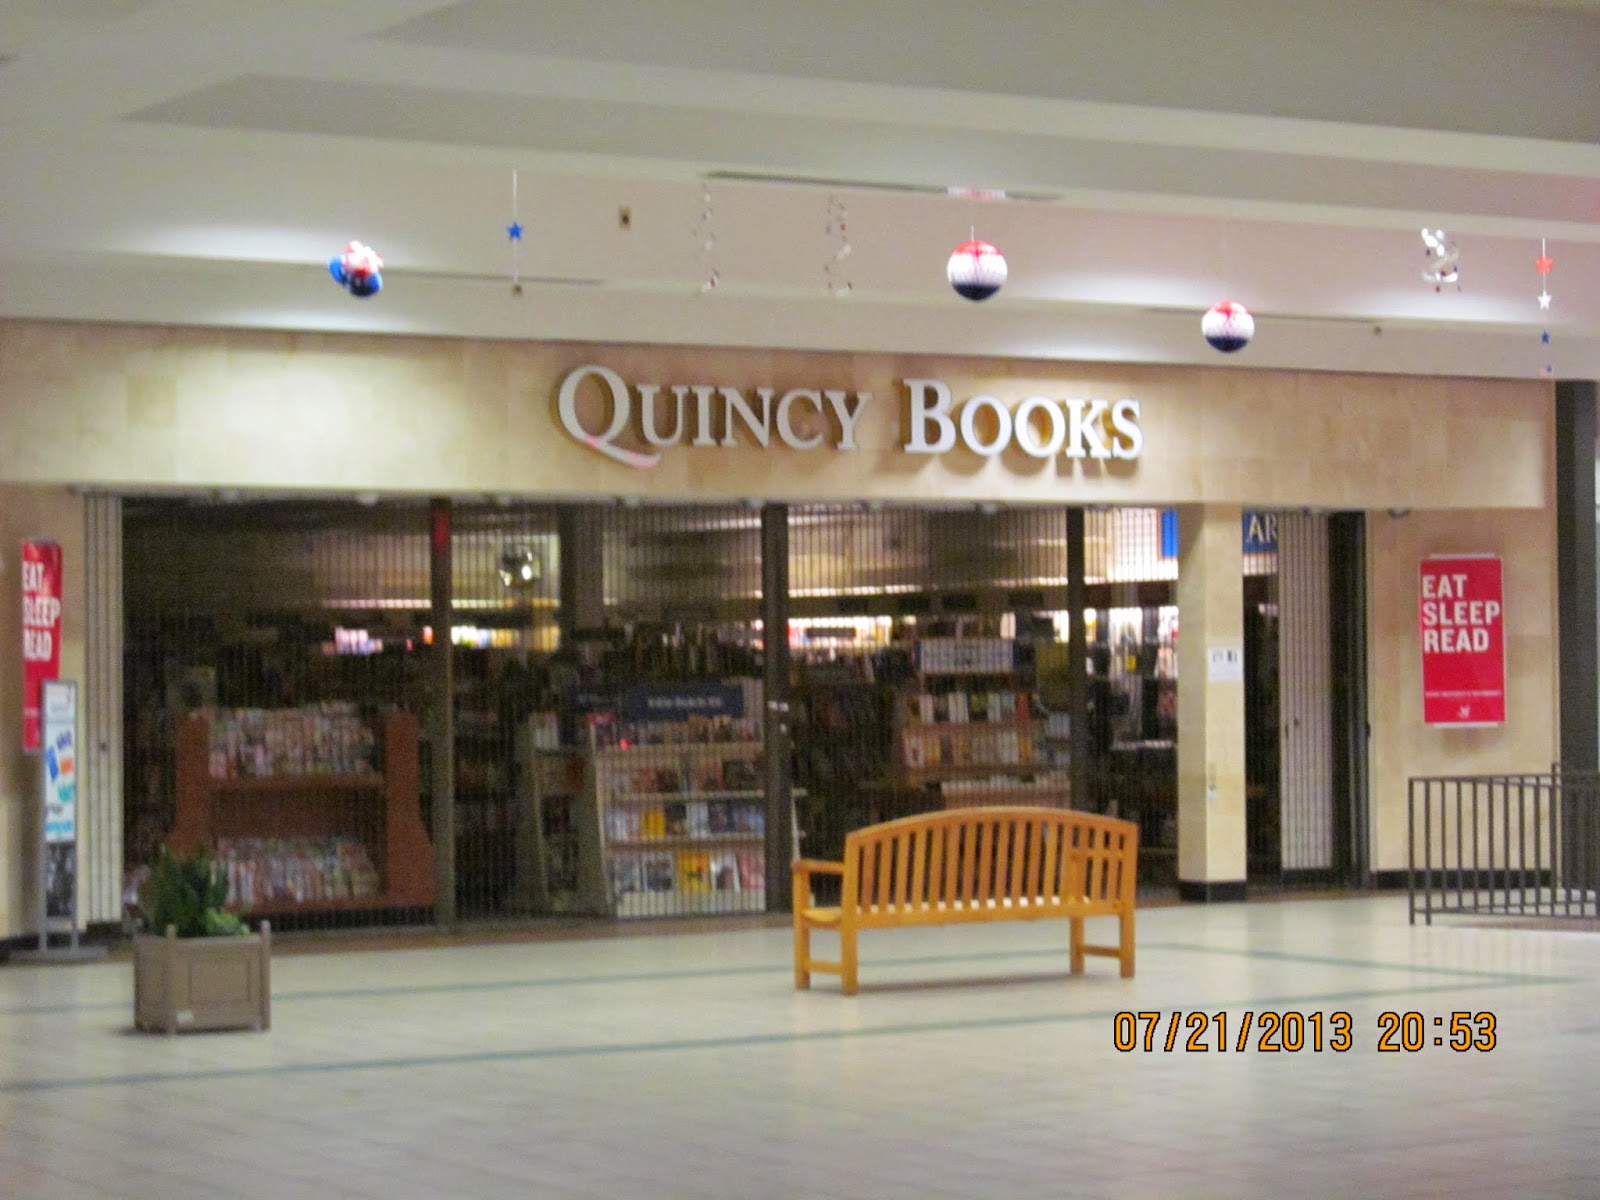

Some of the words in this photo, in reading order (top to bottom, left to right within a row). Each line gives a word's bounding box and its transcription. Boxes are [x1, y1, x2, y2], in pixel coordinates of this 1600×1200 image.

[557, 364, 874, 468] QUINCY
[903, 377, 1145, 459] BOOKS
[1422, 574, 1468, 599] EAT
[1422, 600, 1501, 627] SLEEP
[1424, 627, 1490, 653] READ
